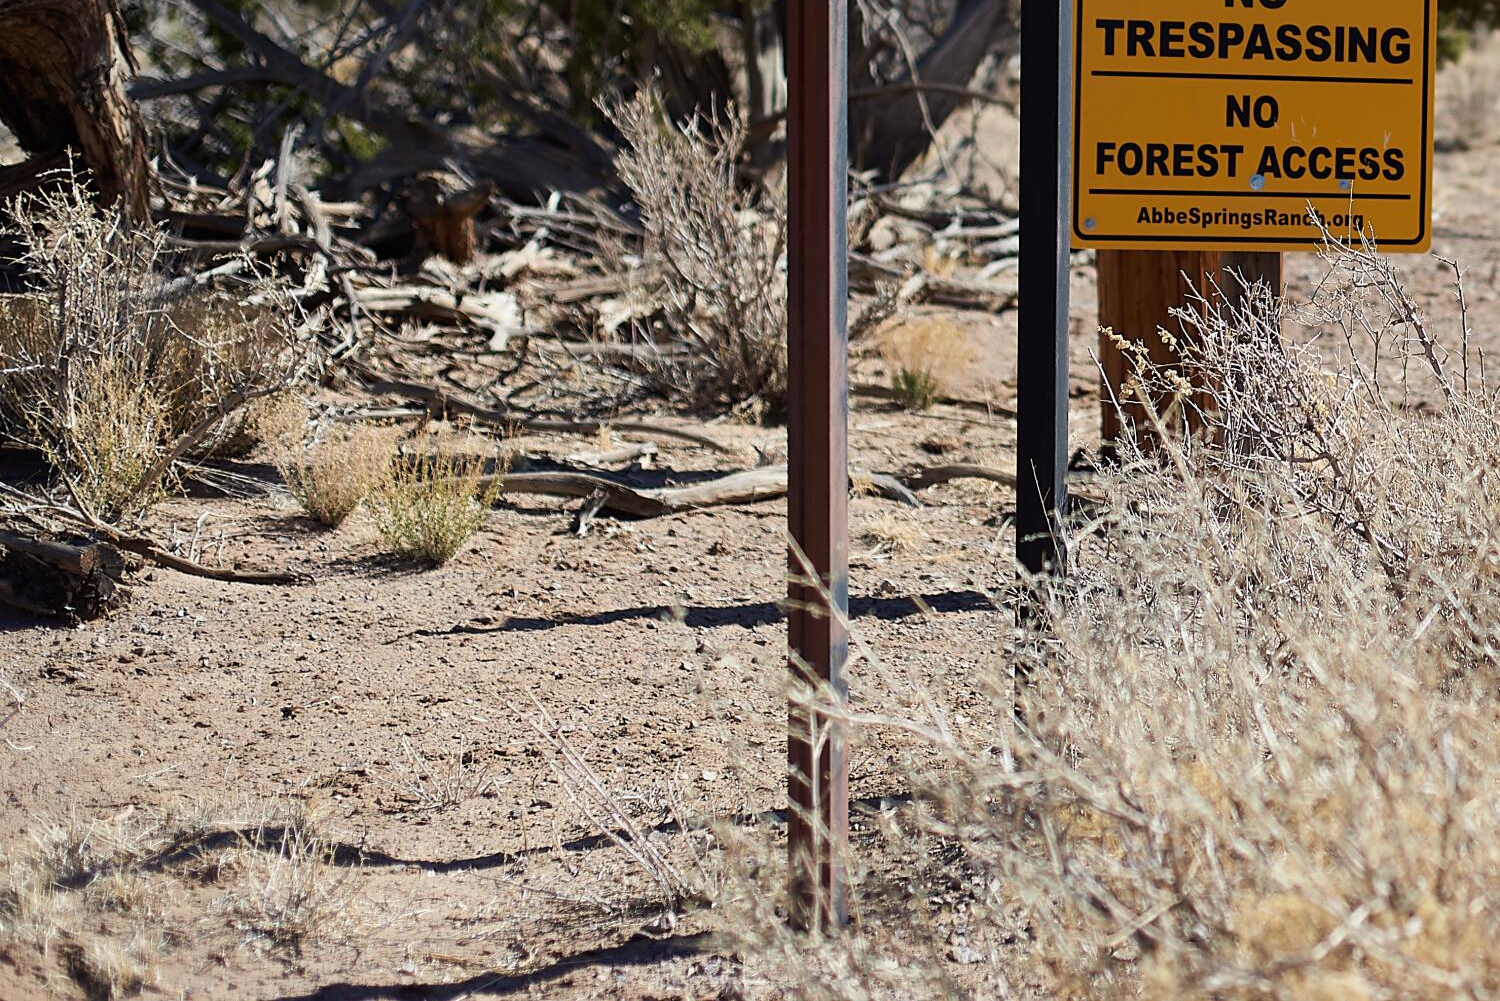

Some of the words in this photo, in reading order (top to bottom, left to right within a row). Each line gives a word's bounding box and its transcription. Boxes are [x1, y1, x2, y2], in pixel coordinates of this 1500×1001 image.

[1095, 19, 1411, 64] TRESPASSING
[1225, 94, 1279, 128] NO
[1095, 142, 1244, 178] FOREST
[1256, 145, 1405, 181] ACCESS
[1136, 206, 1364, 230] AbbeSpringsRanch.org
